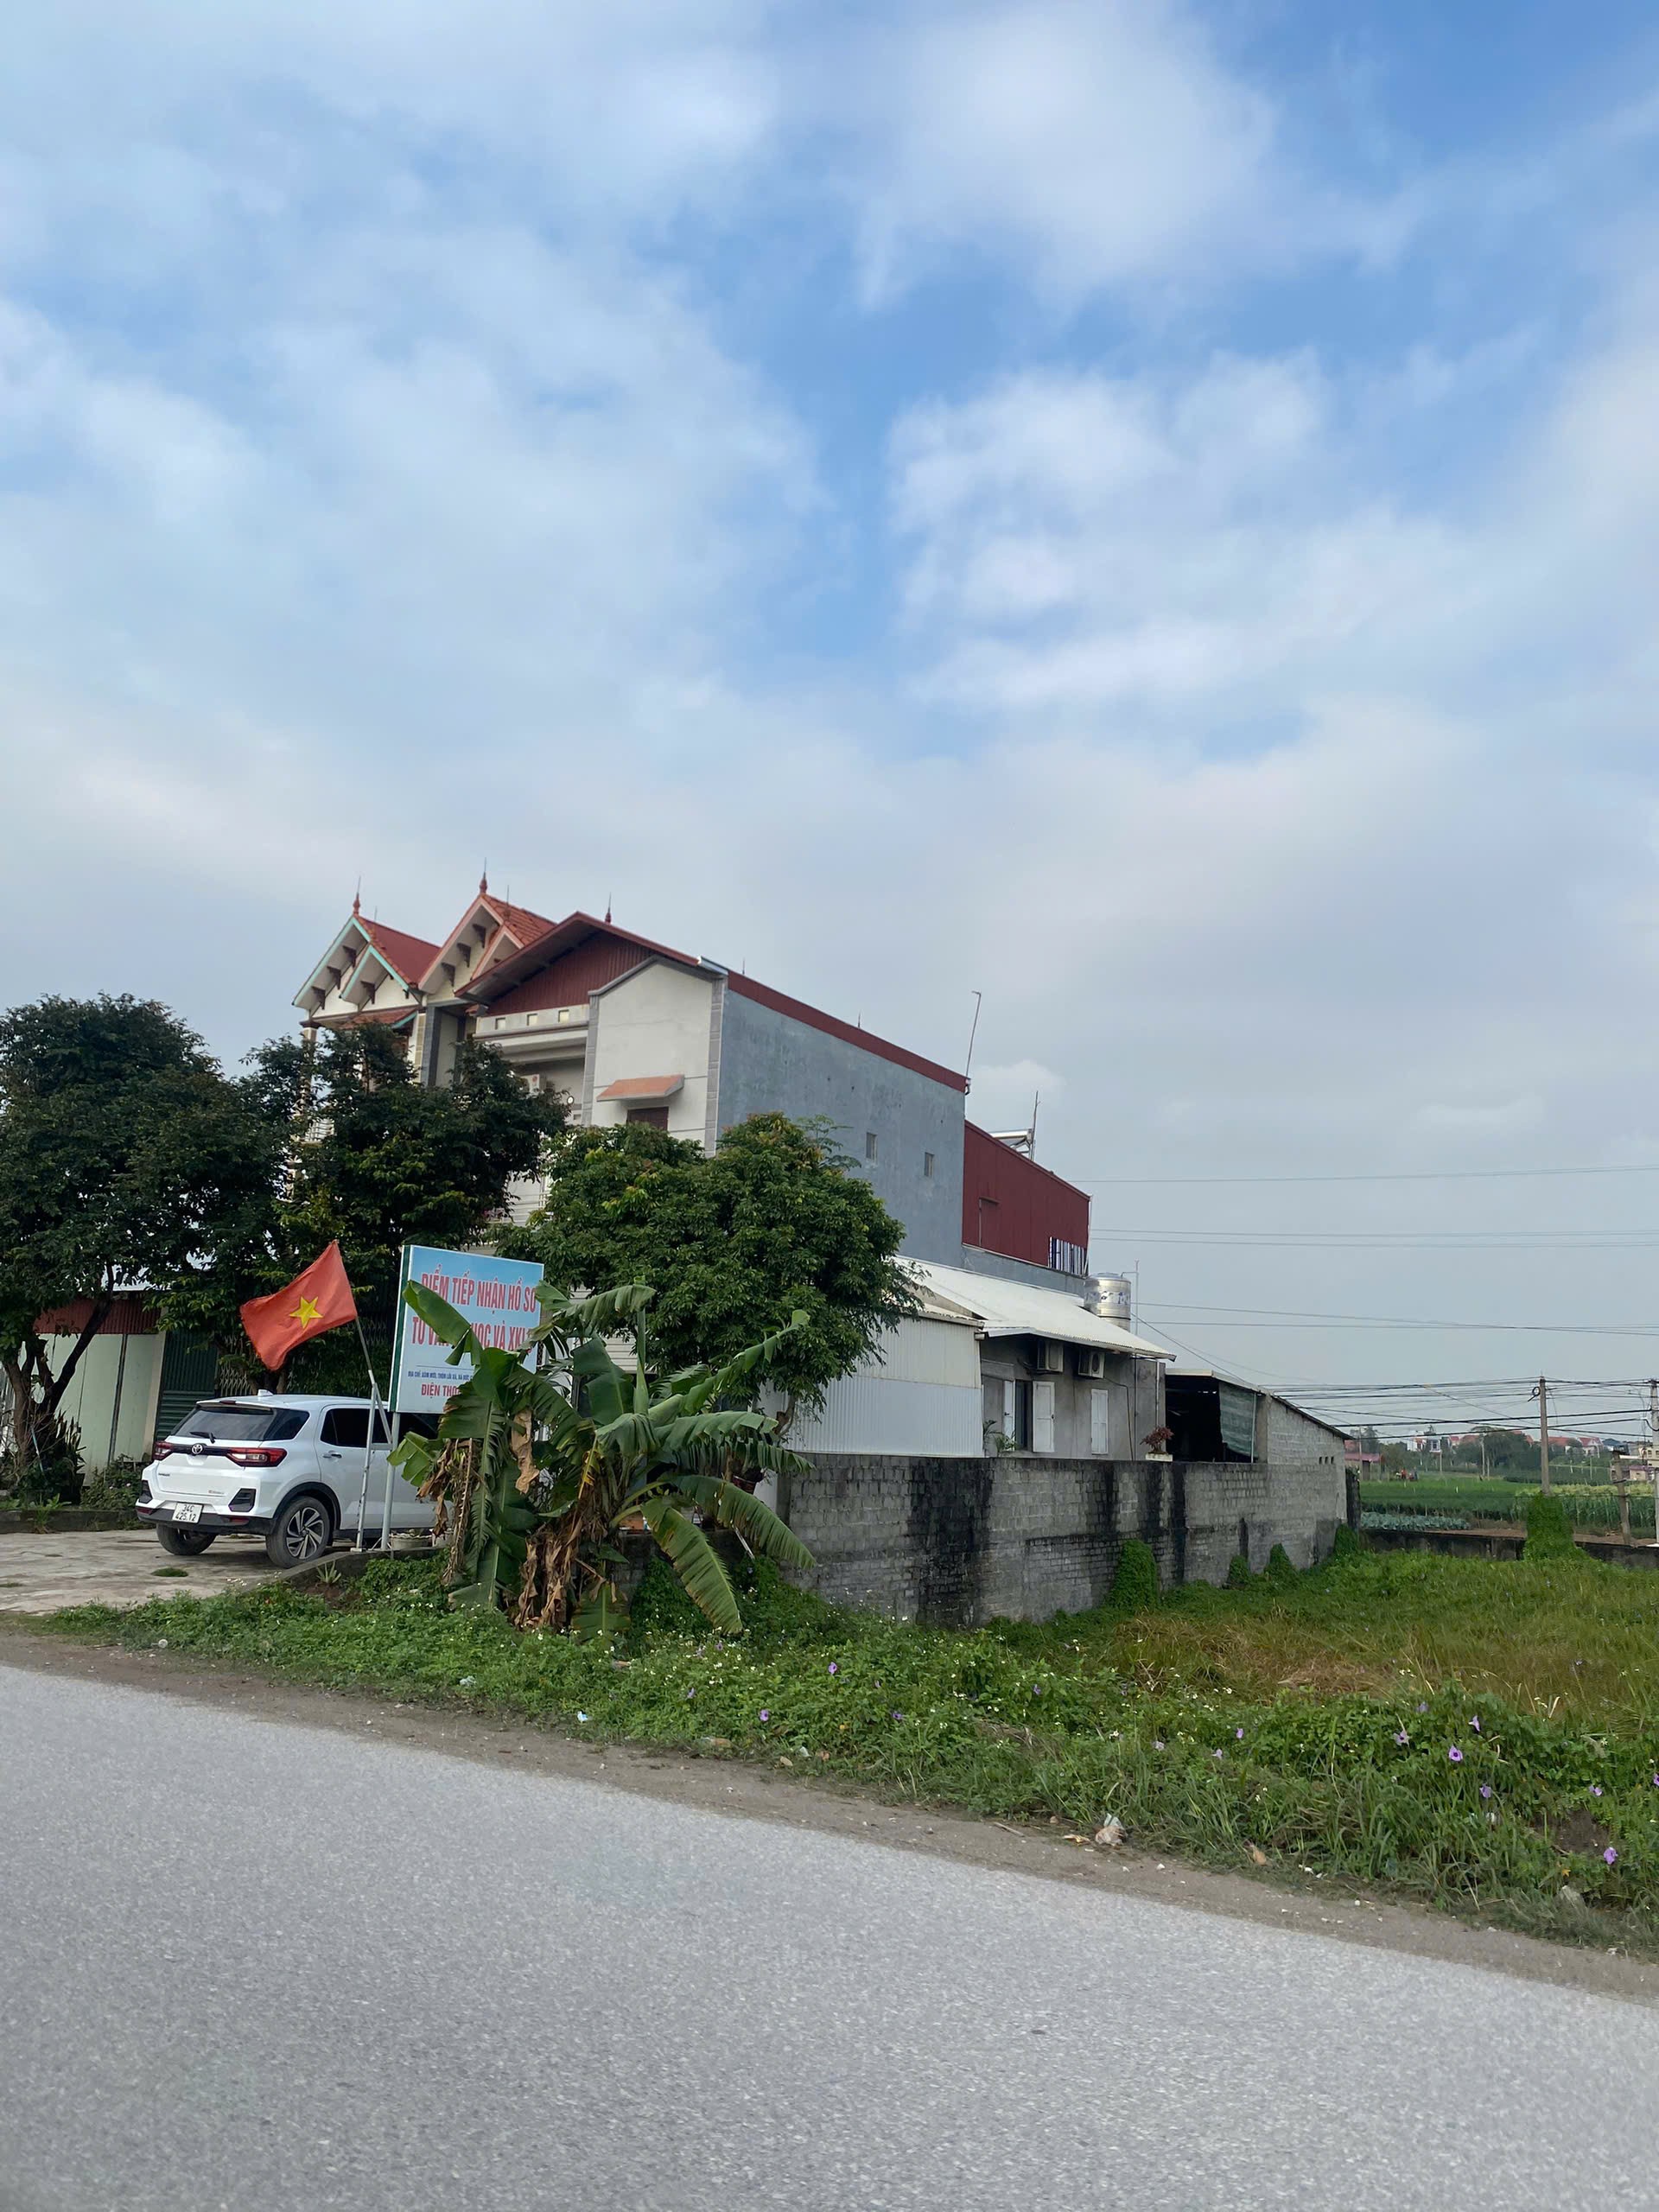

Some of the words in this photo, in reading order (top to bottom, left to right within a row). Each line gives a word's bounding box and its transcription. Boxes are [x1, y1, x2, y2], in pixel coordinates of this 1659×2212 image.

[452, 1270, 474, 1306] TIẾP
[476, 1277, 506, 1314] NHẬN
[421, 1382, 441, 1399] ĐIỆN
[442, 1384, 462, 1397] THO
[182, 1504, 195, 1513] 34C
[175, 1511, 197, 1522] 425.12
